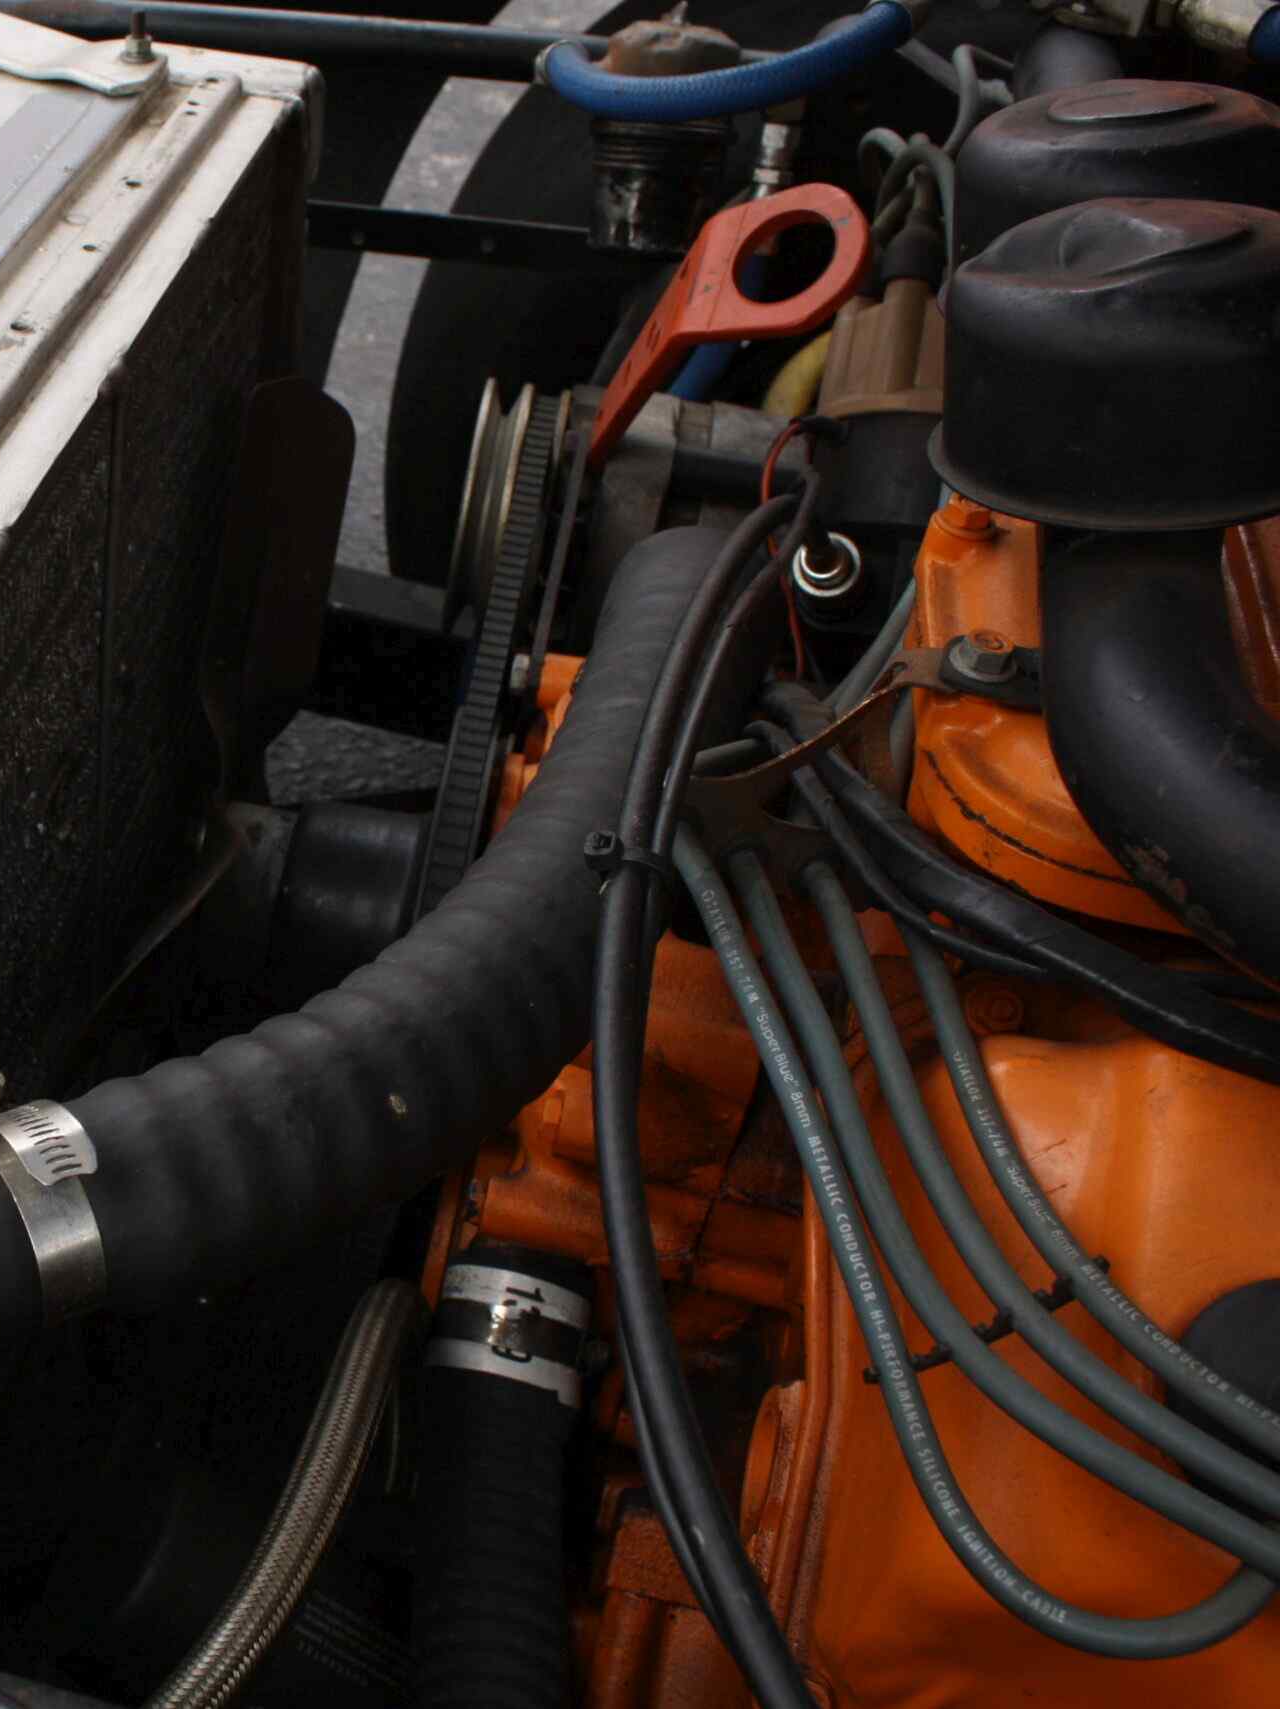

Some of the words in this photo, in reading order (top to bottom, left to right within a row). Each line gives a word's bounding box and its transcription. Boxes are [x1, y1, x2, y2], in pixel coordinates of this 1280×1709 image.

[791, 1091, 812, 1129] 8mm
[808, 1135, 845, 1207] METALLIC
[836, 1212, 877, 1302] CONDUCTOR
[870, 1308, 927, 1441] HI-PERFORMANCE
[918, 1447, 961, 1519] SILICONE
[957, 1523, 1017, 1588] IGNITION
